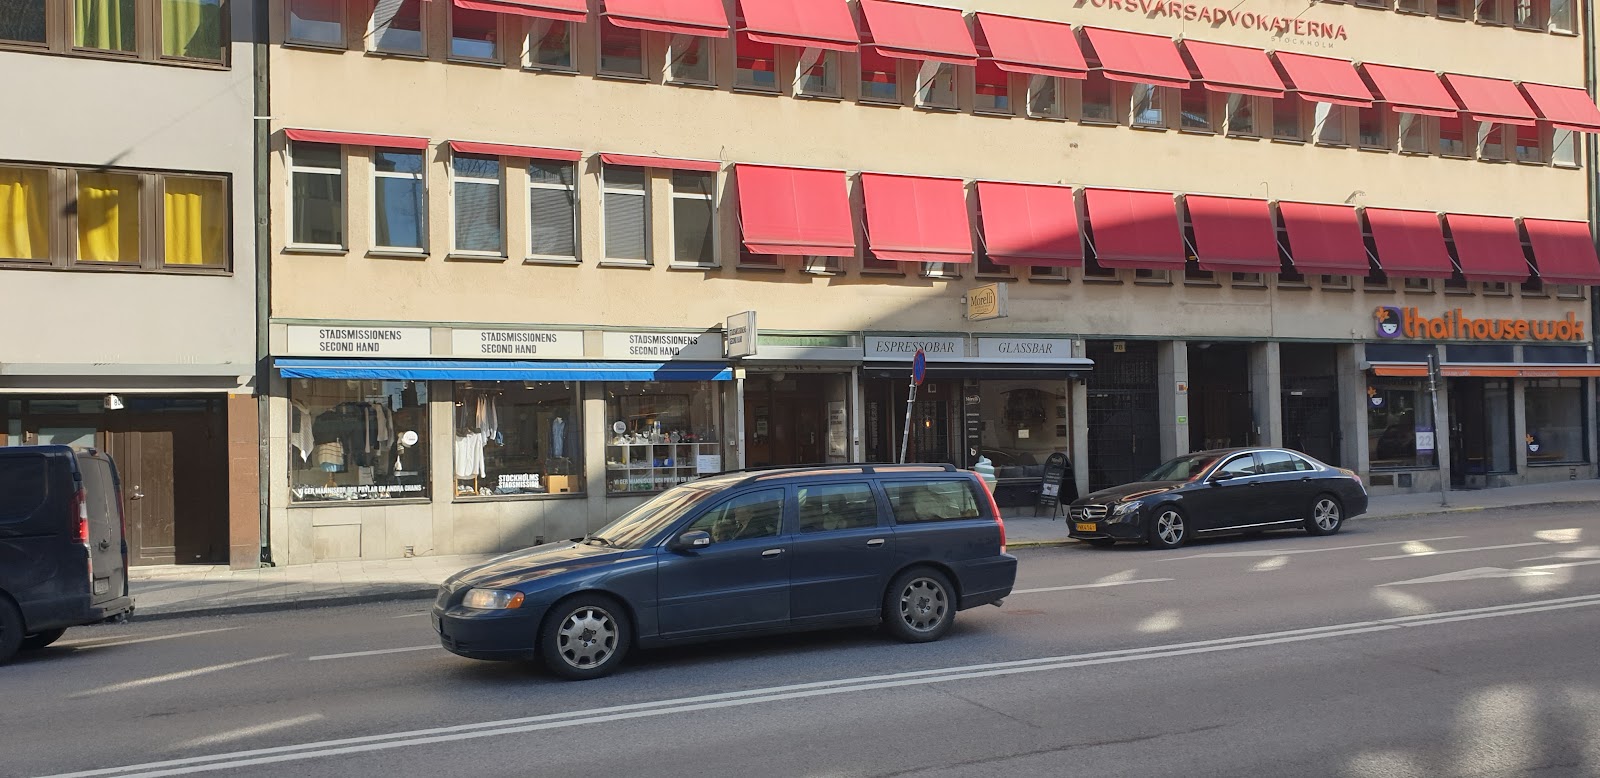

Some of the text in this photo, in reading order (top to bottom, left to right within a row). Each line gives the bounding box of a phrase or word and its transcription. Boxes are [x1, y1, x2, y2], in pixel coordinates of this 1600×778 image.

[1075, 0, 1348, 41] RSVARSADVOKATERNA
[1270, 36, 1334, 48] STOCKHOLM
[970, 292, 993, 306] Morelli
[1402, 306, 1585, 341] thai house wok
[319, 329, 402, 340] STADSMISSIONENS
[481, 332, 557, 342] STADSMISSIONENS
[629, 334, 698, 345] STADSMISSIONENS
[319, 341, 380, 352] SECOND HAND
[481, 343, 537, 354] SECOND HAND
[629, 346, 680, 356] SECOND HAND
[876, 341, 954, 352] ESPRESSOBAR
[998, 342, 1053, 354] GLASSBAR
[1418, 435, 1432, 447] 22
[498, 473, 539, 482] STOCKHOLMS
